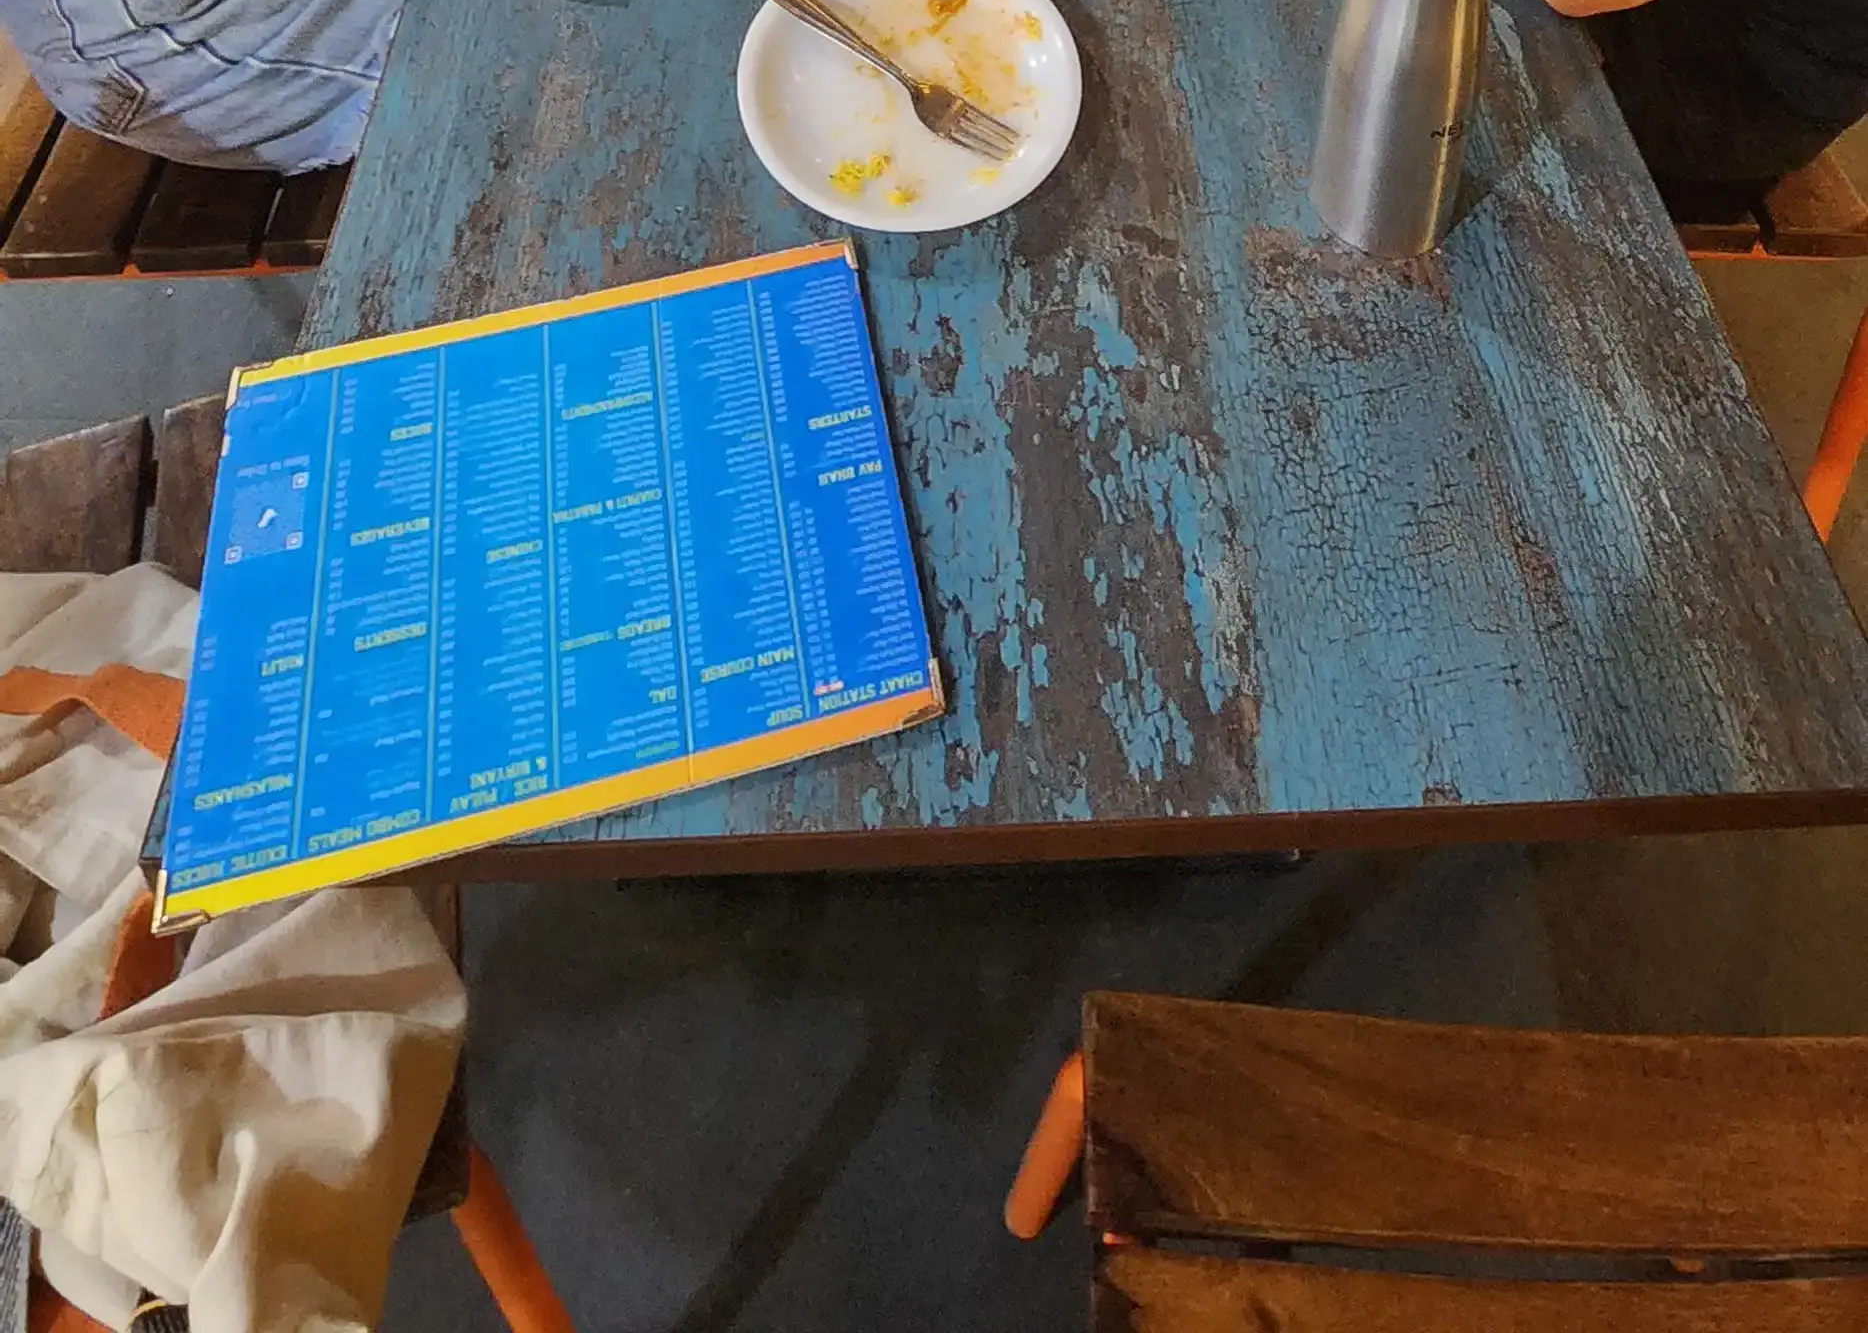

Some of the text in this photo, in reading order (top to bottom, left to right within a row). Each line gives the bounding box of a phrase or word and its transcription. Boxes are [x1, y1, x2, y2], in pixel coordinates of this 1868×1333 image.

[807, 405, 872, 429] STARTERS
[859, 460, 883, 477] PAV
[617, 614, 671, 639] BREADS
[758, 645, 794, 667] MAIN
[700, 656, 754, 682] COURSE
[878, 670, 923, 694] CHAAT
[648, 685, 677, 704] DAL
[818, 683, 875, 712] STATION
[766, 705, 803, 725] SOUP
[513, 774, 547, 795] RICE
[307, 825, 363, 852] MEALS
